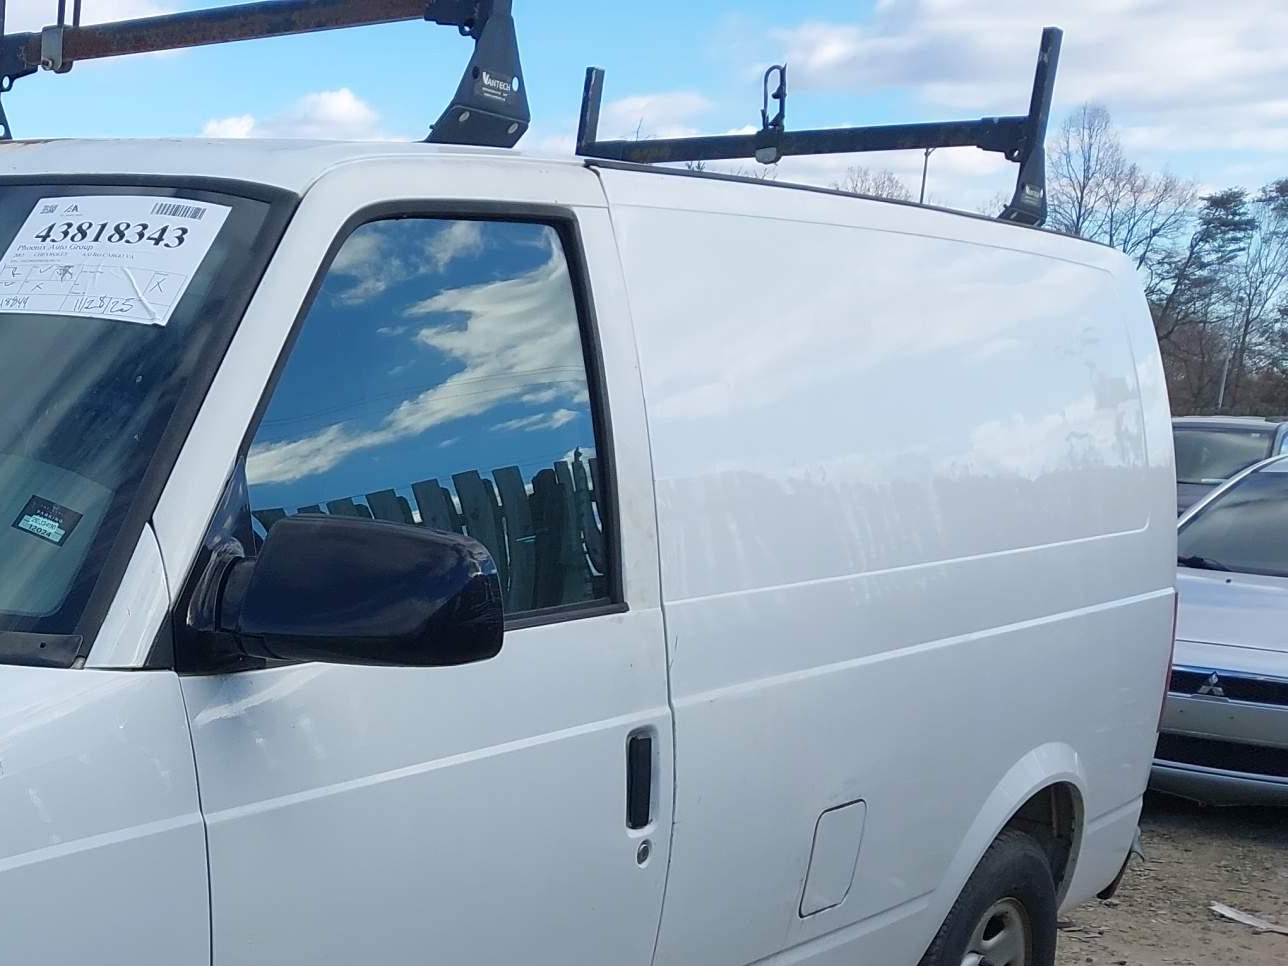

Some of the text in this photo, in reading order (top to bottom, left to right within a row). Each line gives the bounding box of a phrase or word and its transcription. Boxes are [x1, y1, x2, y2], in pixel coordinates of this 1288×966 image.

[482, 72, 511, 91] VANTECH
[35, 221, 188, 248] 43818343
[69, 243, 94, 251] Group
[73, 296, 135, 313] 11/28/25
